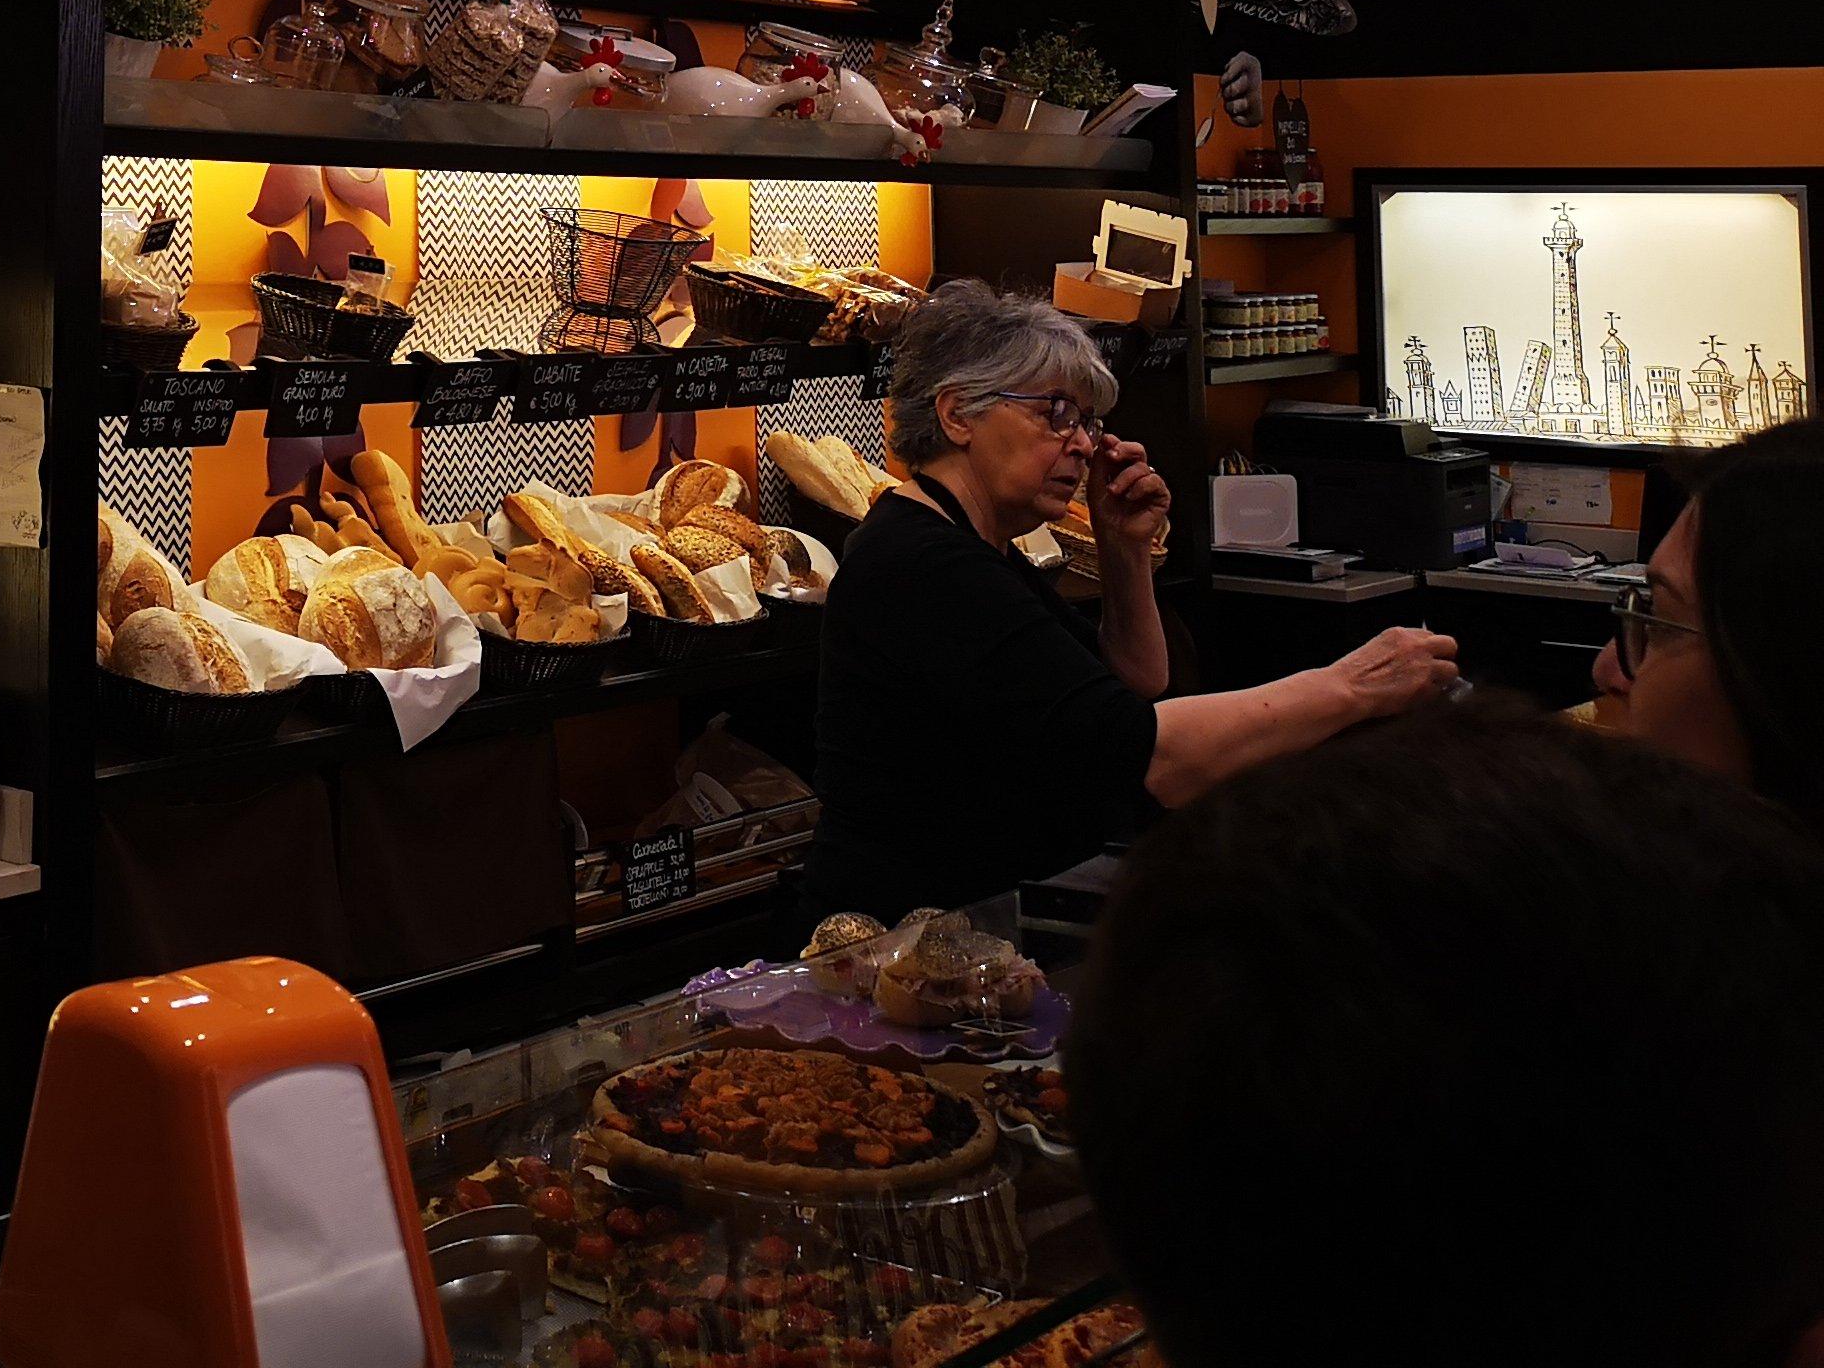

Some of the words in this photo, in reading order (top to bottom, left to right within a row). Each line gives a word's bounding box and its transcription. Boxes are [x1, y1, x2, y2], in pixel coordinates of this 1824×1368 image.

[1233, 1, 1280, 24] merci
[295, 367, 337, 385] SEMOLA
[533, 363, 584, 385] CIABATTE
[688, 354, 730, 378] CASSETTA
[164, 377, 226, 396] TOSCANO
[282, 385, 317, 404] GRANO
[321, 385, 346, 401] DURO
[140, 398, 176, 413] SALATO
[191, 414, 217, 435] 5,00
